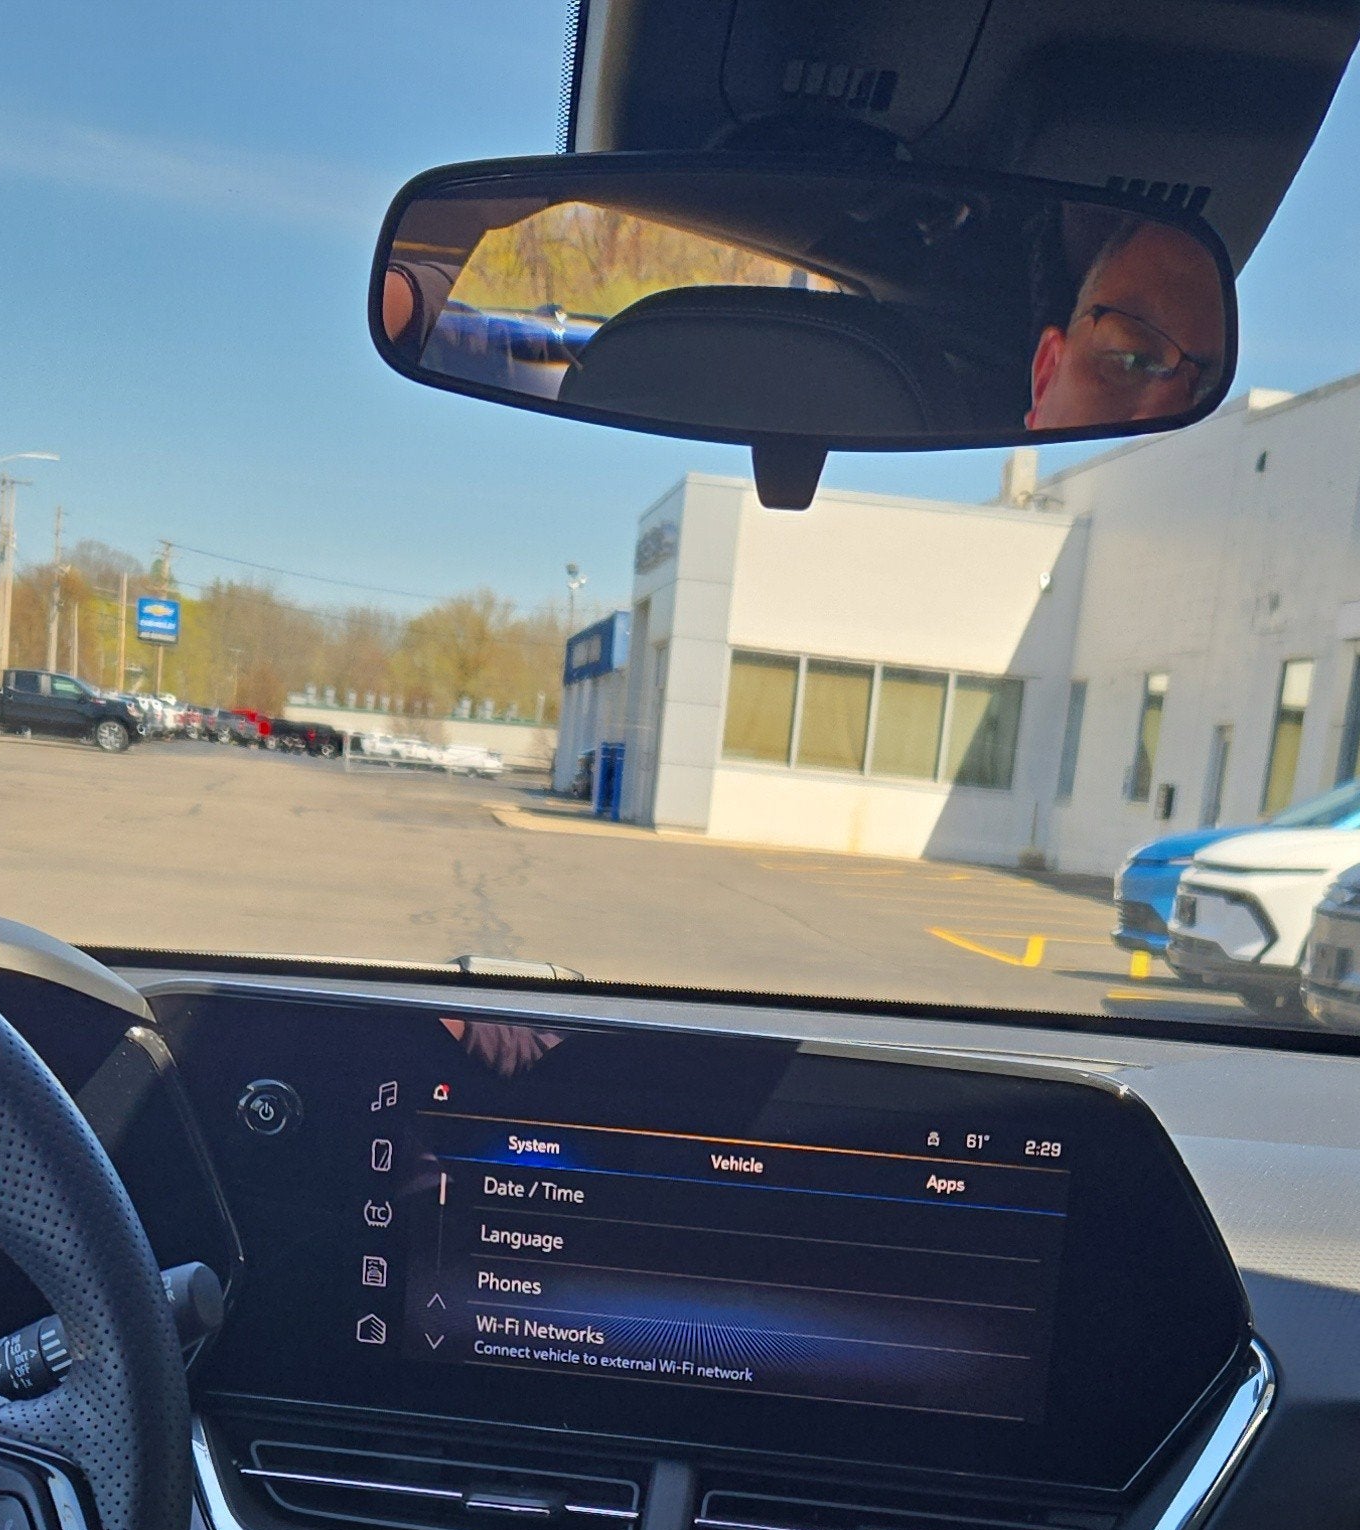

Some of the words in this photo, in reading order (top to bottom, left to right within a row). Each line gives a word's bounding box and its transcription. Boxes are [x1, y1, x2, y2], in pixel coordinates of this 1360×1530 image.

[508, 1135, 560, 1154] System
[1024, 1140, 1062, 1158] 2:29
[710, 1154, 764, 1174] Vehicle
[484, 1176, 524, 1198] Date
[541, 1182, 584, 1203] Time
[926, 1174, 966, 1194] Apps
[480, 1224, 564, 1253] Language
[477, 1271, 541, 1295] Phones
[475, 1315, 520, 1335] Wi-Fi
[524, 1320, 605, 1345] Networks
[474, 1340, 531, 1360] Connect
[533, 1347, 580, 1365] vehicle
[583, 1352, 598, 1366] to
[600, 1355, 657, 1372] external
[658, 1359, 694, 1376] Wi-Fi
[697, 1366, 753, 1382] network
